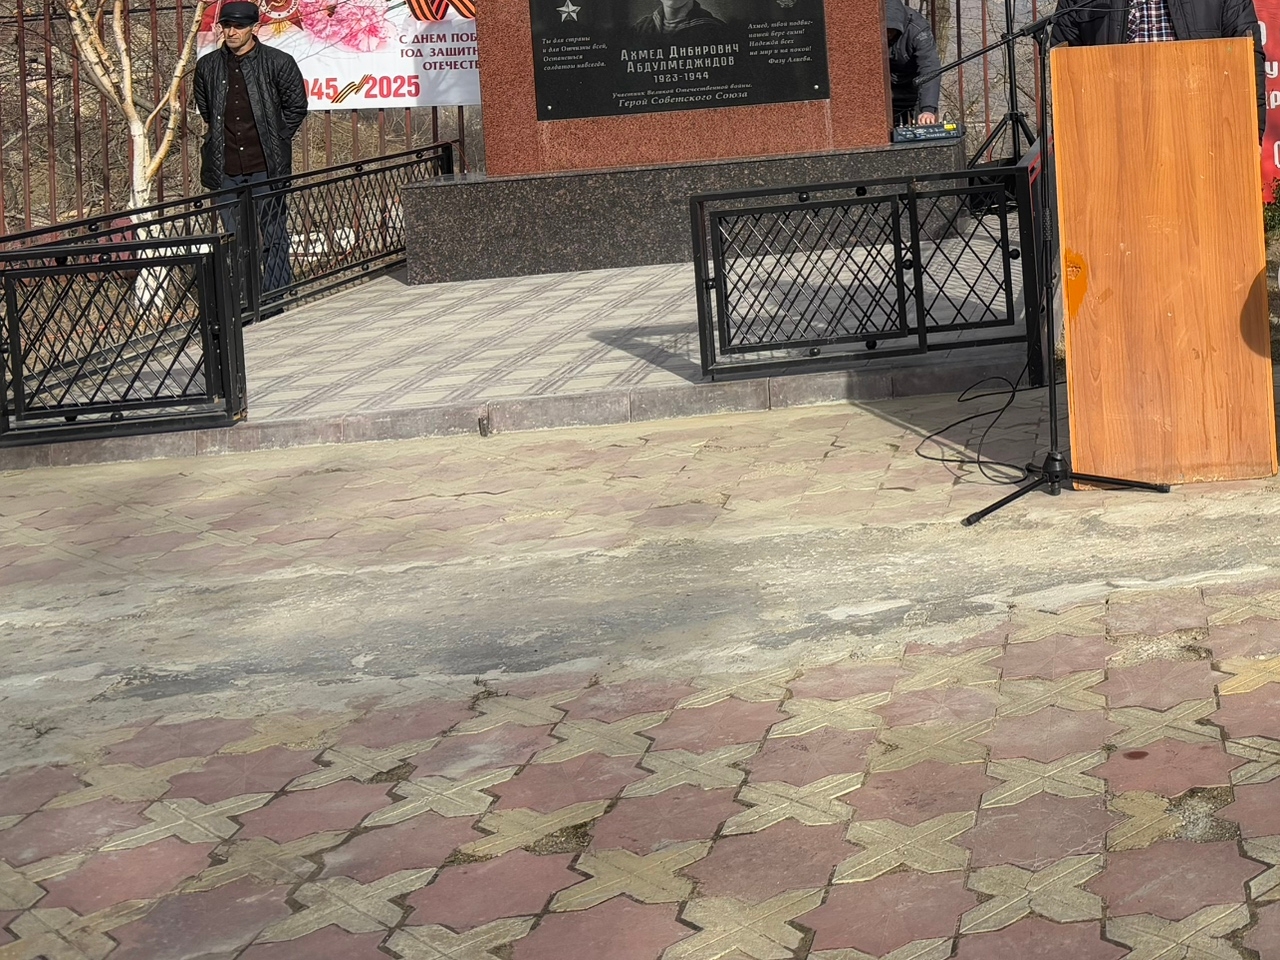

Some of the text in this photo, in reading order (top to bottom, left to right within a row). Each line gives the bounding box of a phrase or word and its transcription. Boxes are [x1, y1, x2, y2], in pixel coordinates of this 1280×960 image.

[399, 34, 408, 44] С
[412, 33, 447, 44] ДНЕМ
[400, 48, 423, 58] ГОД
[654, 71, 709, 83] 1923-1944
[364, 74, 420, 98] 2025
[647, 88, 674, 96] Великой
[675, 85, 728, 93] Отечественной
[618, 91, 748, 108] Герой Советского Союза
